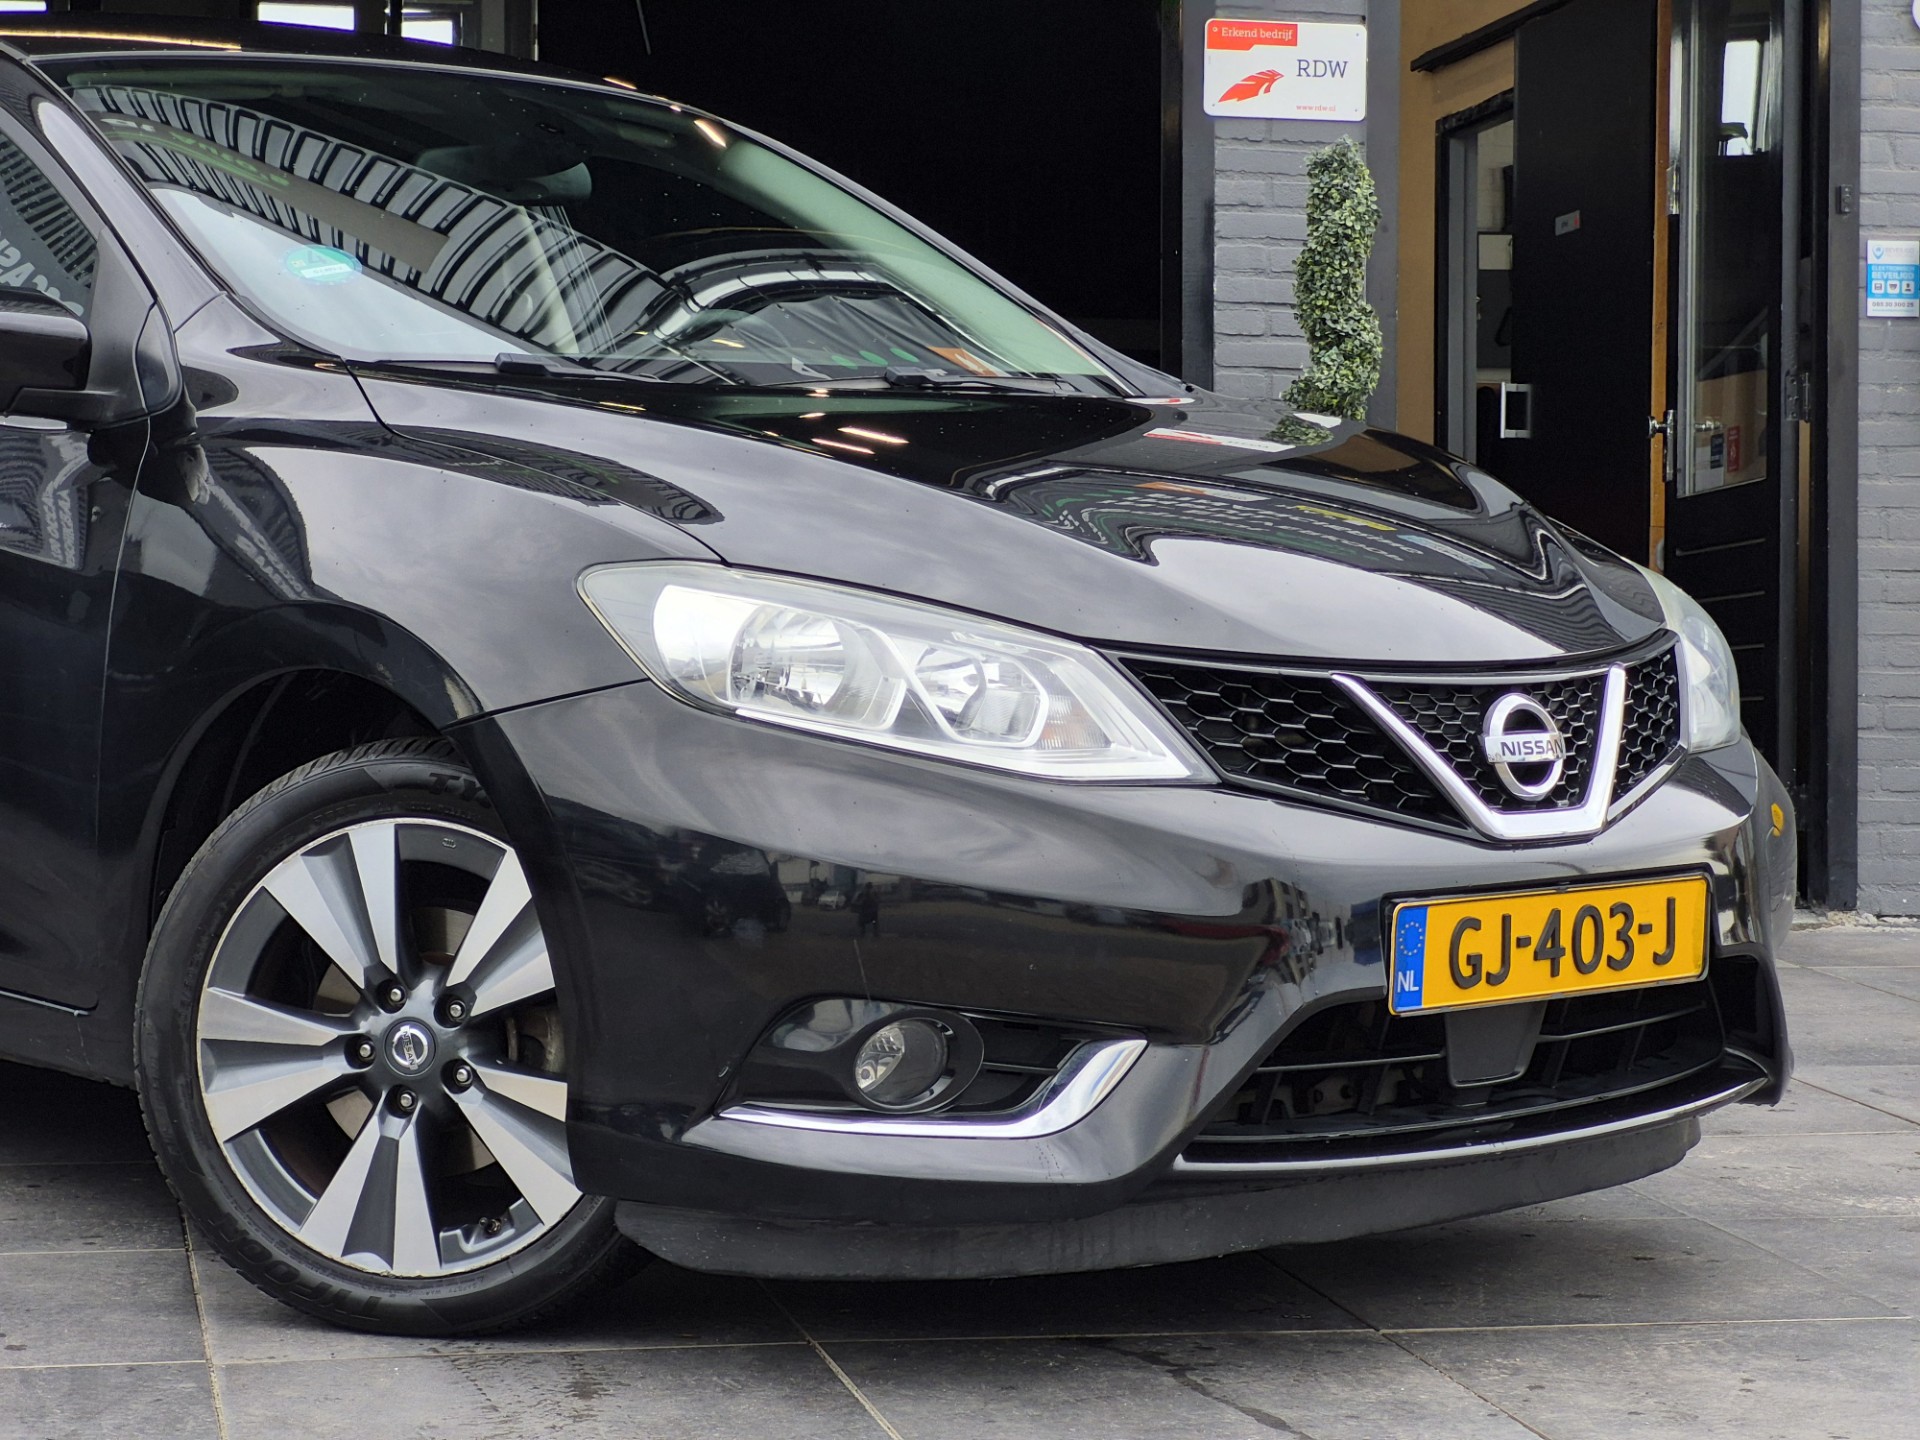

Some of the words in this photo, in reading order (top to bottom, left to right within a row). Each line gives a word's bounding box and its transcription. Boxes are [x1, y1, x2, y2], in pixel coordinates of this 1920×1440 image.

[1221, 27, 1258, 38] Erkend
[1259, 28, 1293, 41] bedrijf
[1296, 59, 1348, 78] RDW
[1296, 104, 1336, 112] www.rdw.nl
[1500, 739, 1563, 757] NISSAN
[1449, 896, 1676, 990] GJ-403-J
[1397, 970, 1419, 993] NL
